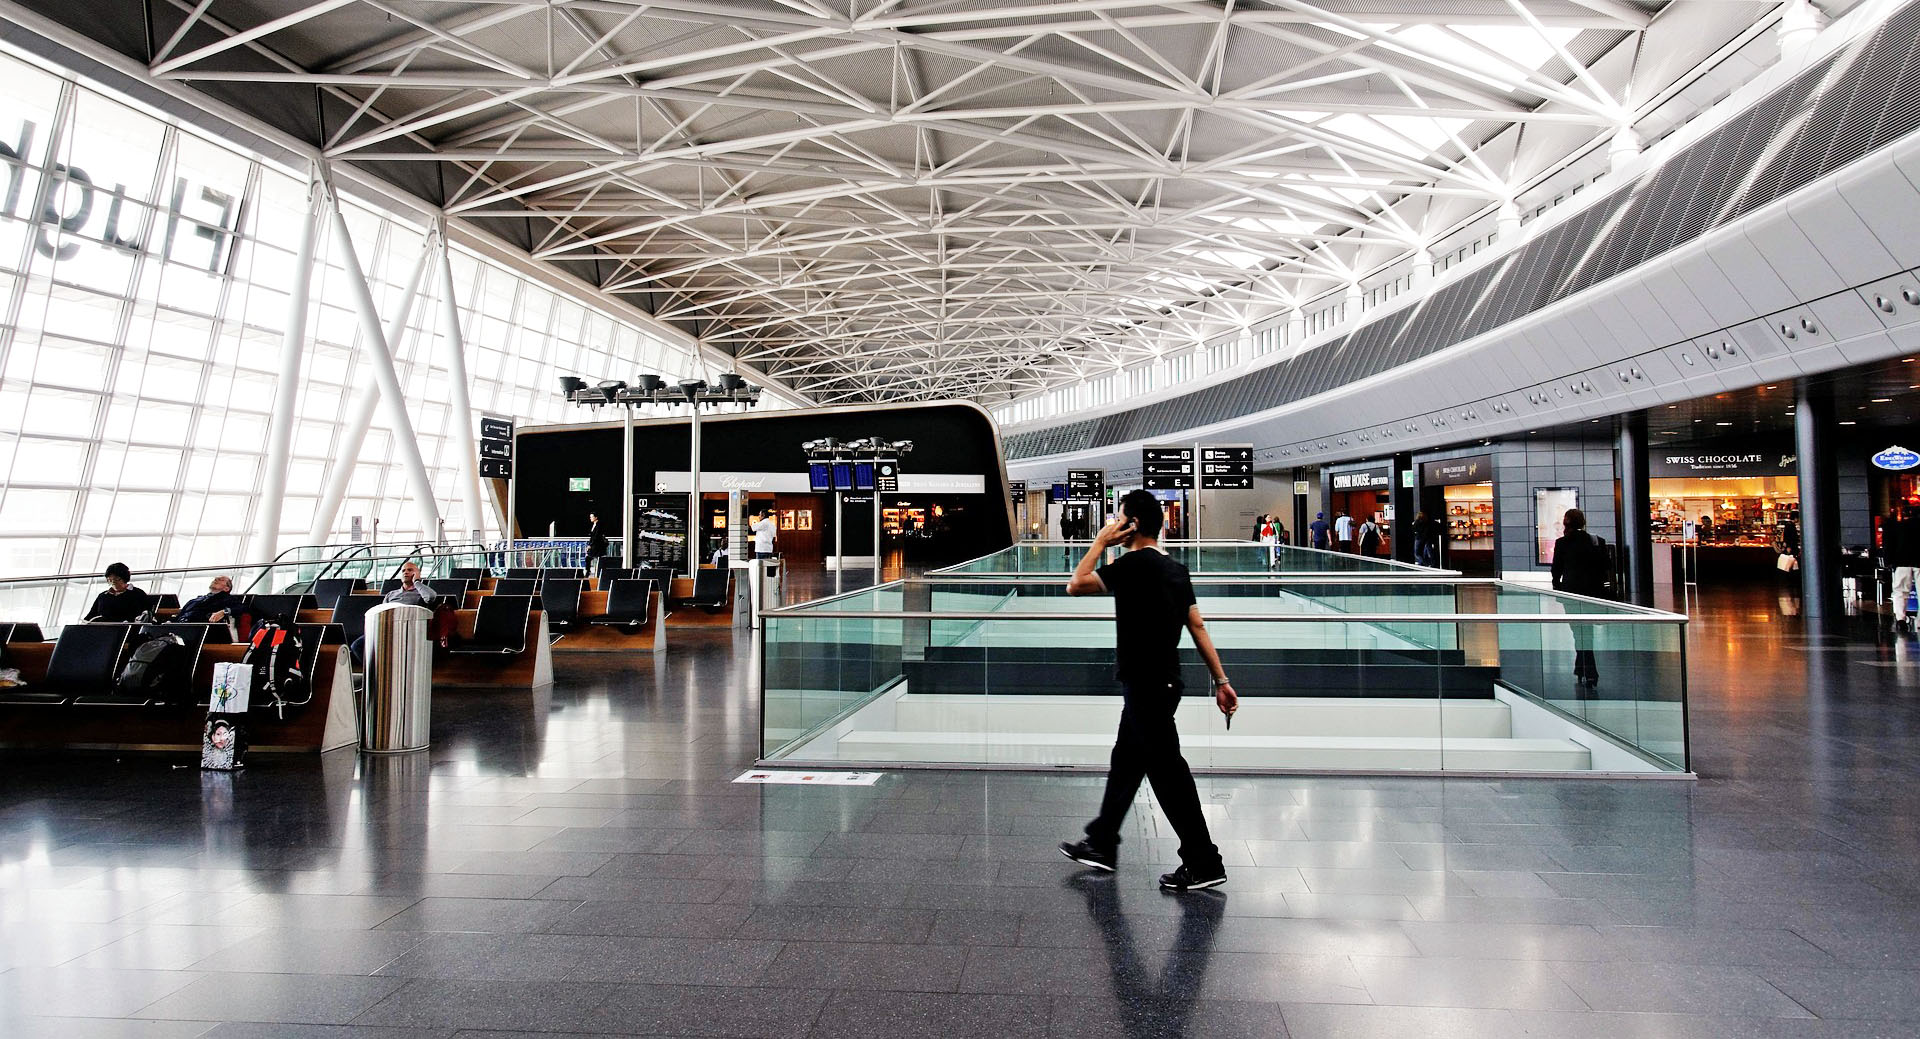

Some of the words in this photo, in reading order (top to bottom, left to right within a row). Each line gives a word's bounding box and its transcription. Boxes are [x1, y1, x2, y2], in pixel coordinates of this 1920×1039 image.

[1665, 456, 1695, 464] SWISS
[1697, 455, 1762, 464] CHOCOLATE
[499, 464, 504, 475] E
[719, 475, 766, 490] Chopard
[1174, 479, 1181, 487] E
[1214, 479, 1221, 487] A
[1333, 475, 1351, 488] CAVIAR
[1351, 473, 1370, 487] HOUSE
